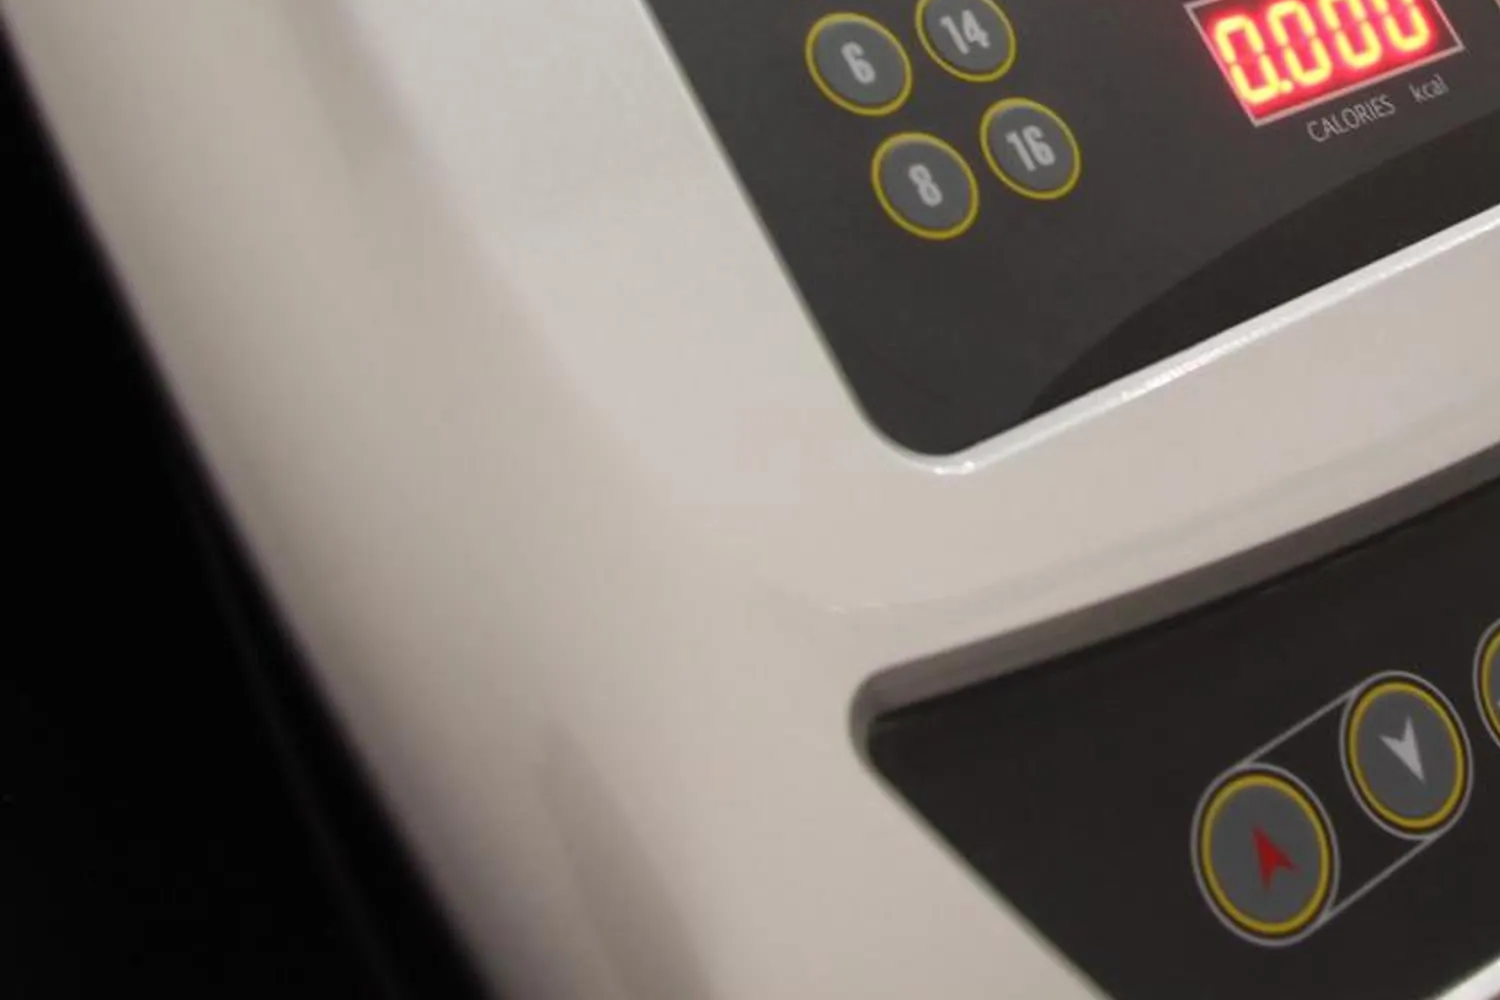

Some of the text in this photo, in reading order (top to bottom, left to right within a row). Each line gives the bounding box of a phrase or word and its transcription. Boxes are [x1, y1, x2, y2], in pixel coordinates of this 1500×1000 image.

[940, 9, 990, 55] 14
[840, 41, 877, 85] 6
[1306, 73, 1449, 142] CALORIES kcal
[1005, 124, 1057, 172] 16
[908, 163, 944, 207] 8
